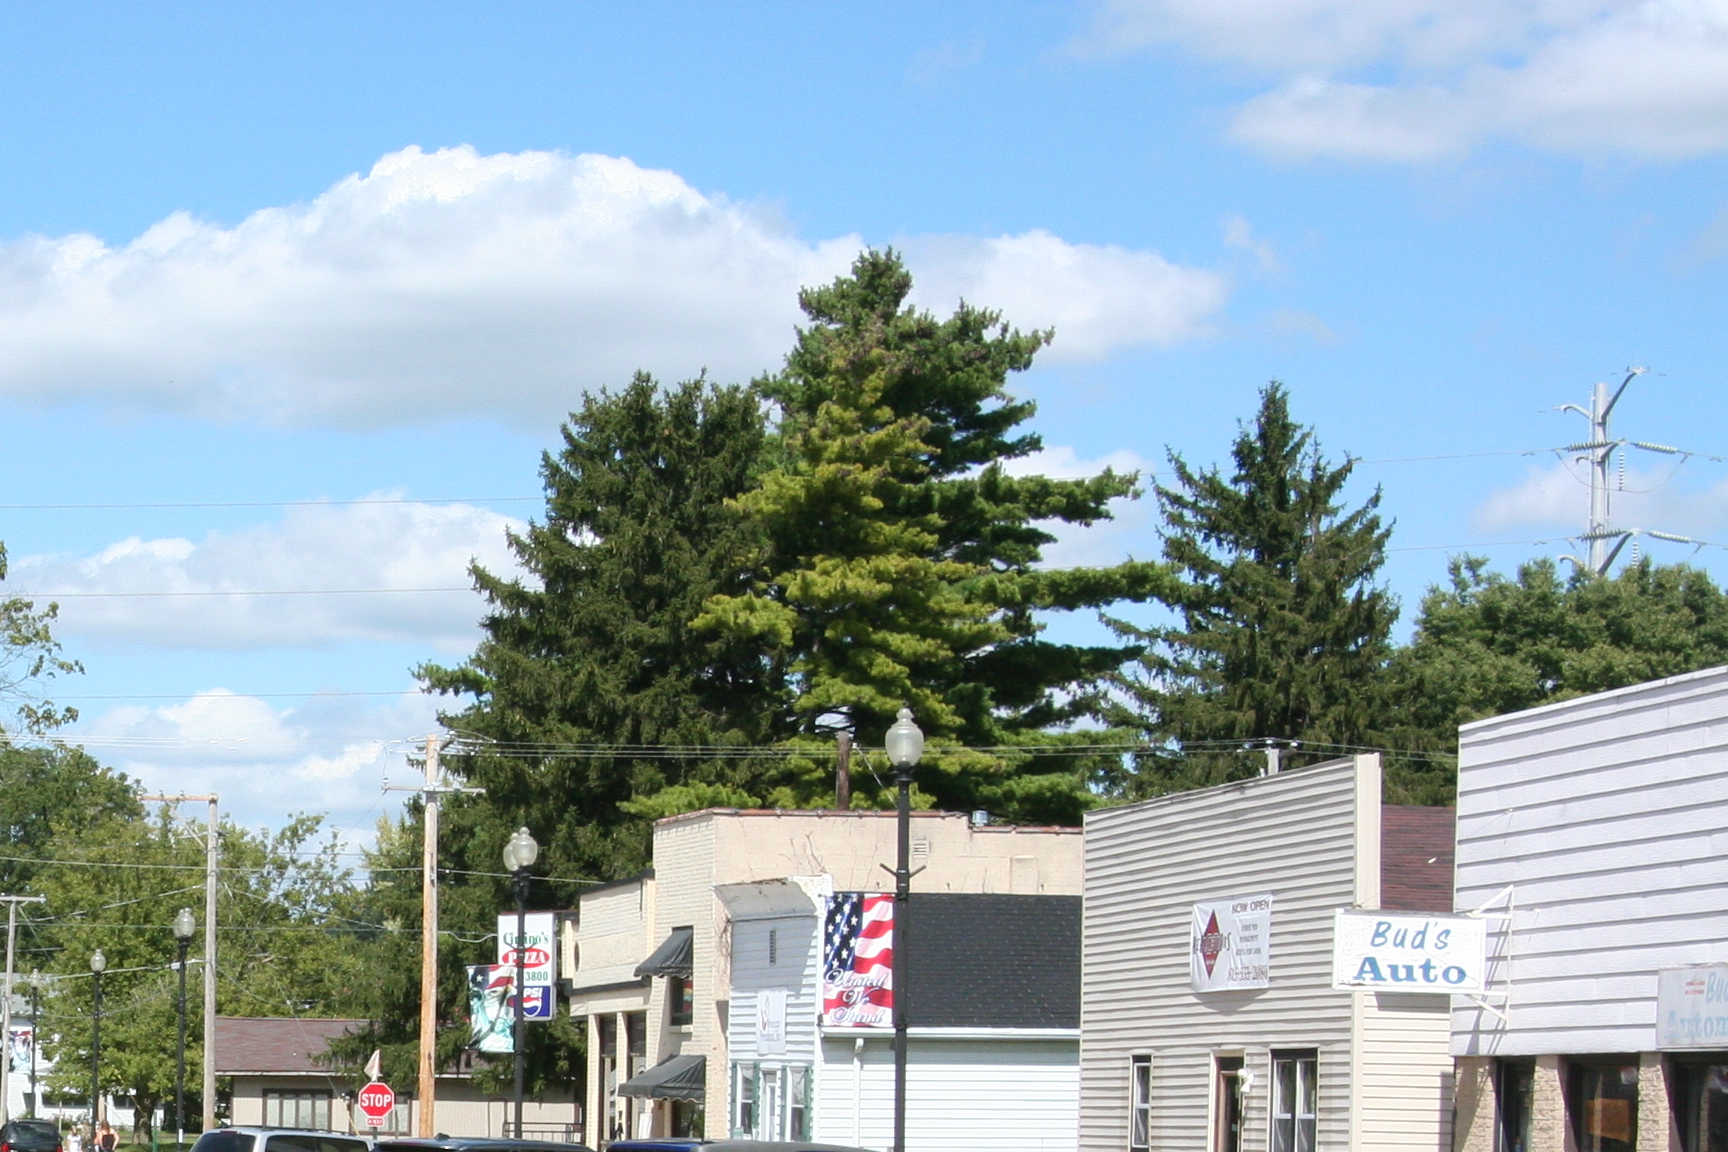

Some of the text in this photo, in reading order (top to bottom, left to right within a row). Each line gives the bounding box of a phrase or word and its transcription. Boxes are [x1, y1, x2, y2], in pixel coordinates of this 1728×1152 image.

[1250, 899, 1270, 911] OPEN
[1370, 920, 1452, 951] Bud's
[508, 951, 546, 964] PZZA
[826, 968, 888, 989] United
[1352, 956, 1468, 985] Auto
[842, 987, 880, 1005] We
[361, 1093, 392, 1108] STOP
